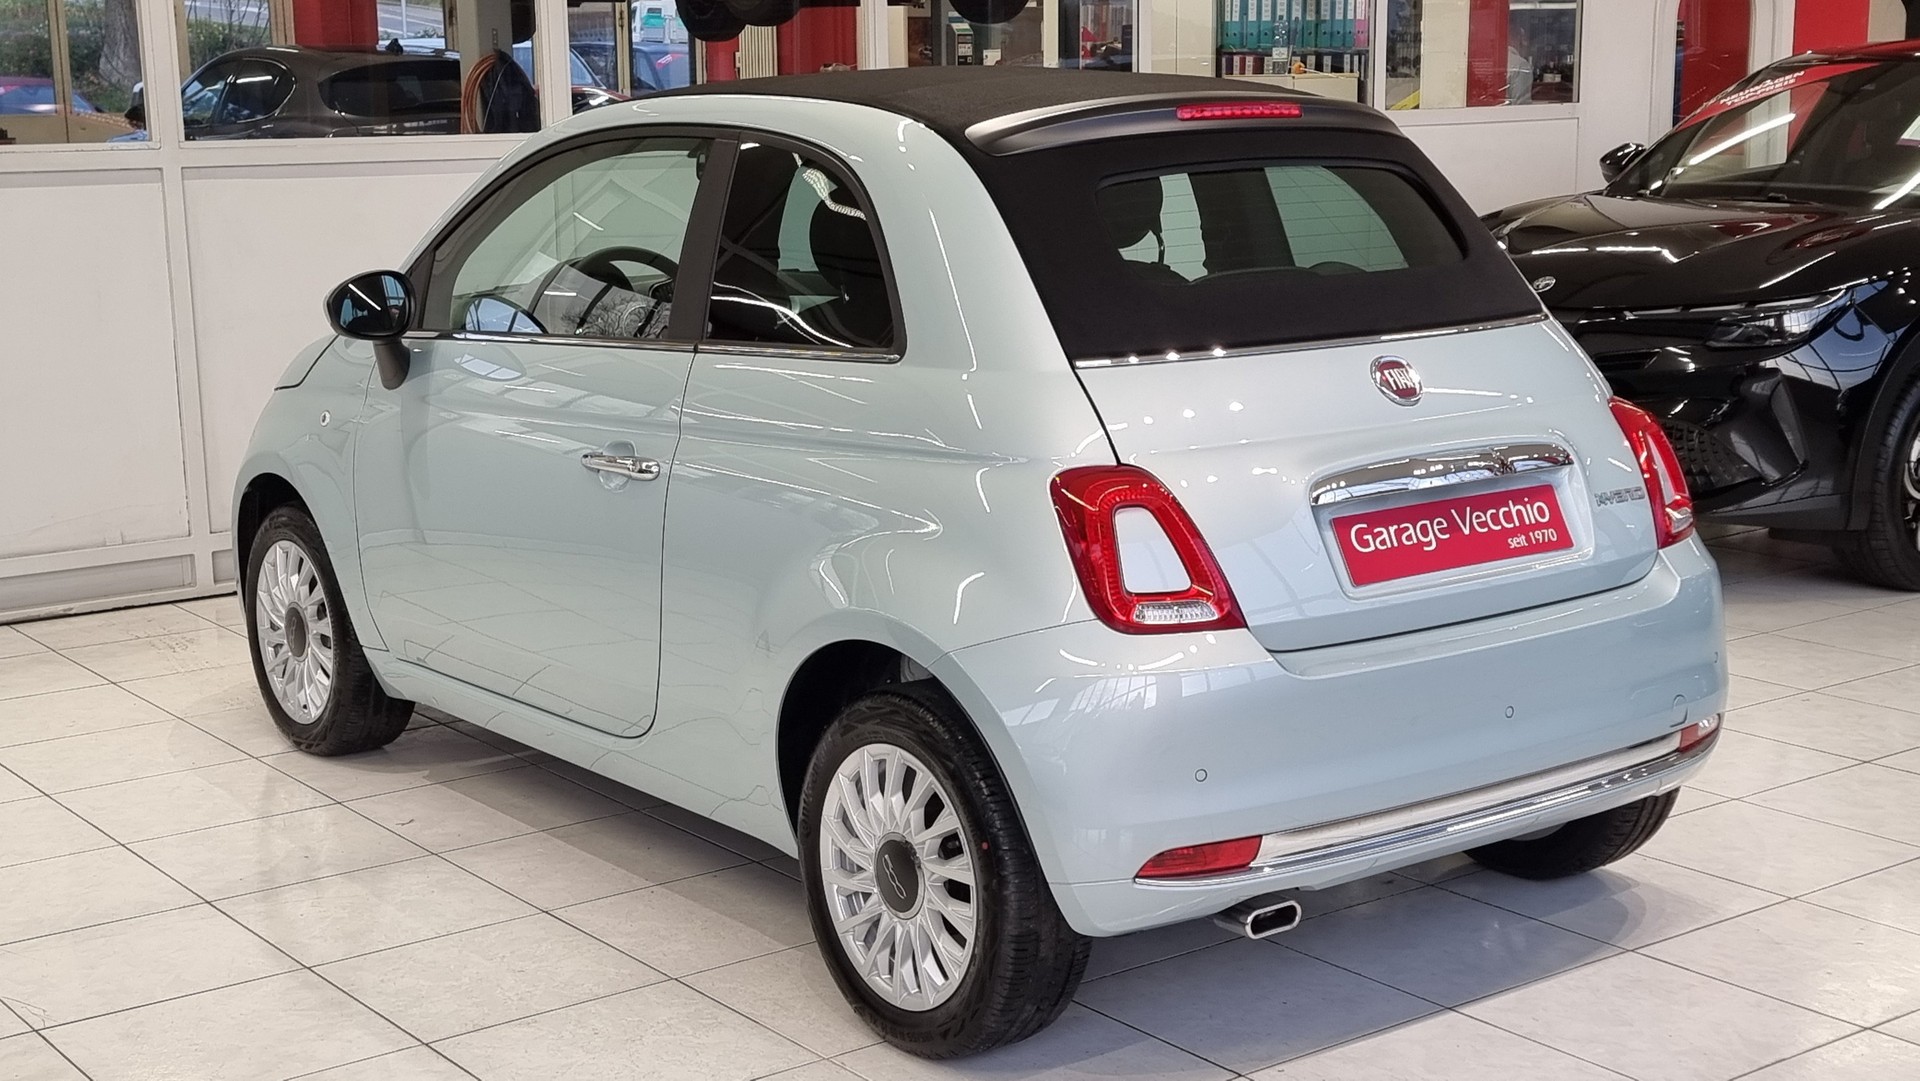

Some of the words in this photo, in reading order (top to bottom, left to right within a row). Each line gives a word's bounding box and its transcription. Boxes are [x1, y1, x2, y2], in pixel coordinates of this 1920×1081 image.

[1383, 367, 1417, 391] FIAT
[1351, 517, 1450, 552] Garage
[1450, 498, 1550, 536] Vecchio
[1507, 533, 1528, 549] seit
[1529, 528, 1558, 545] 1970
